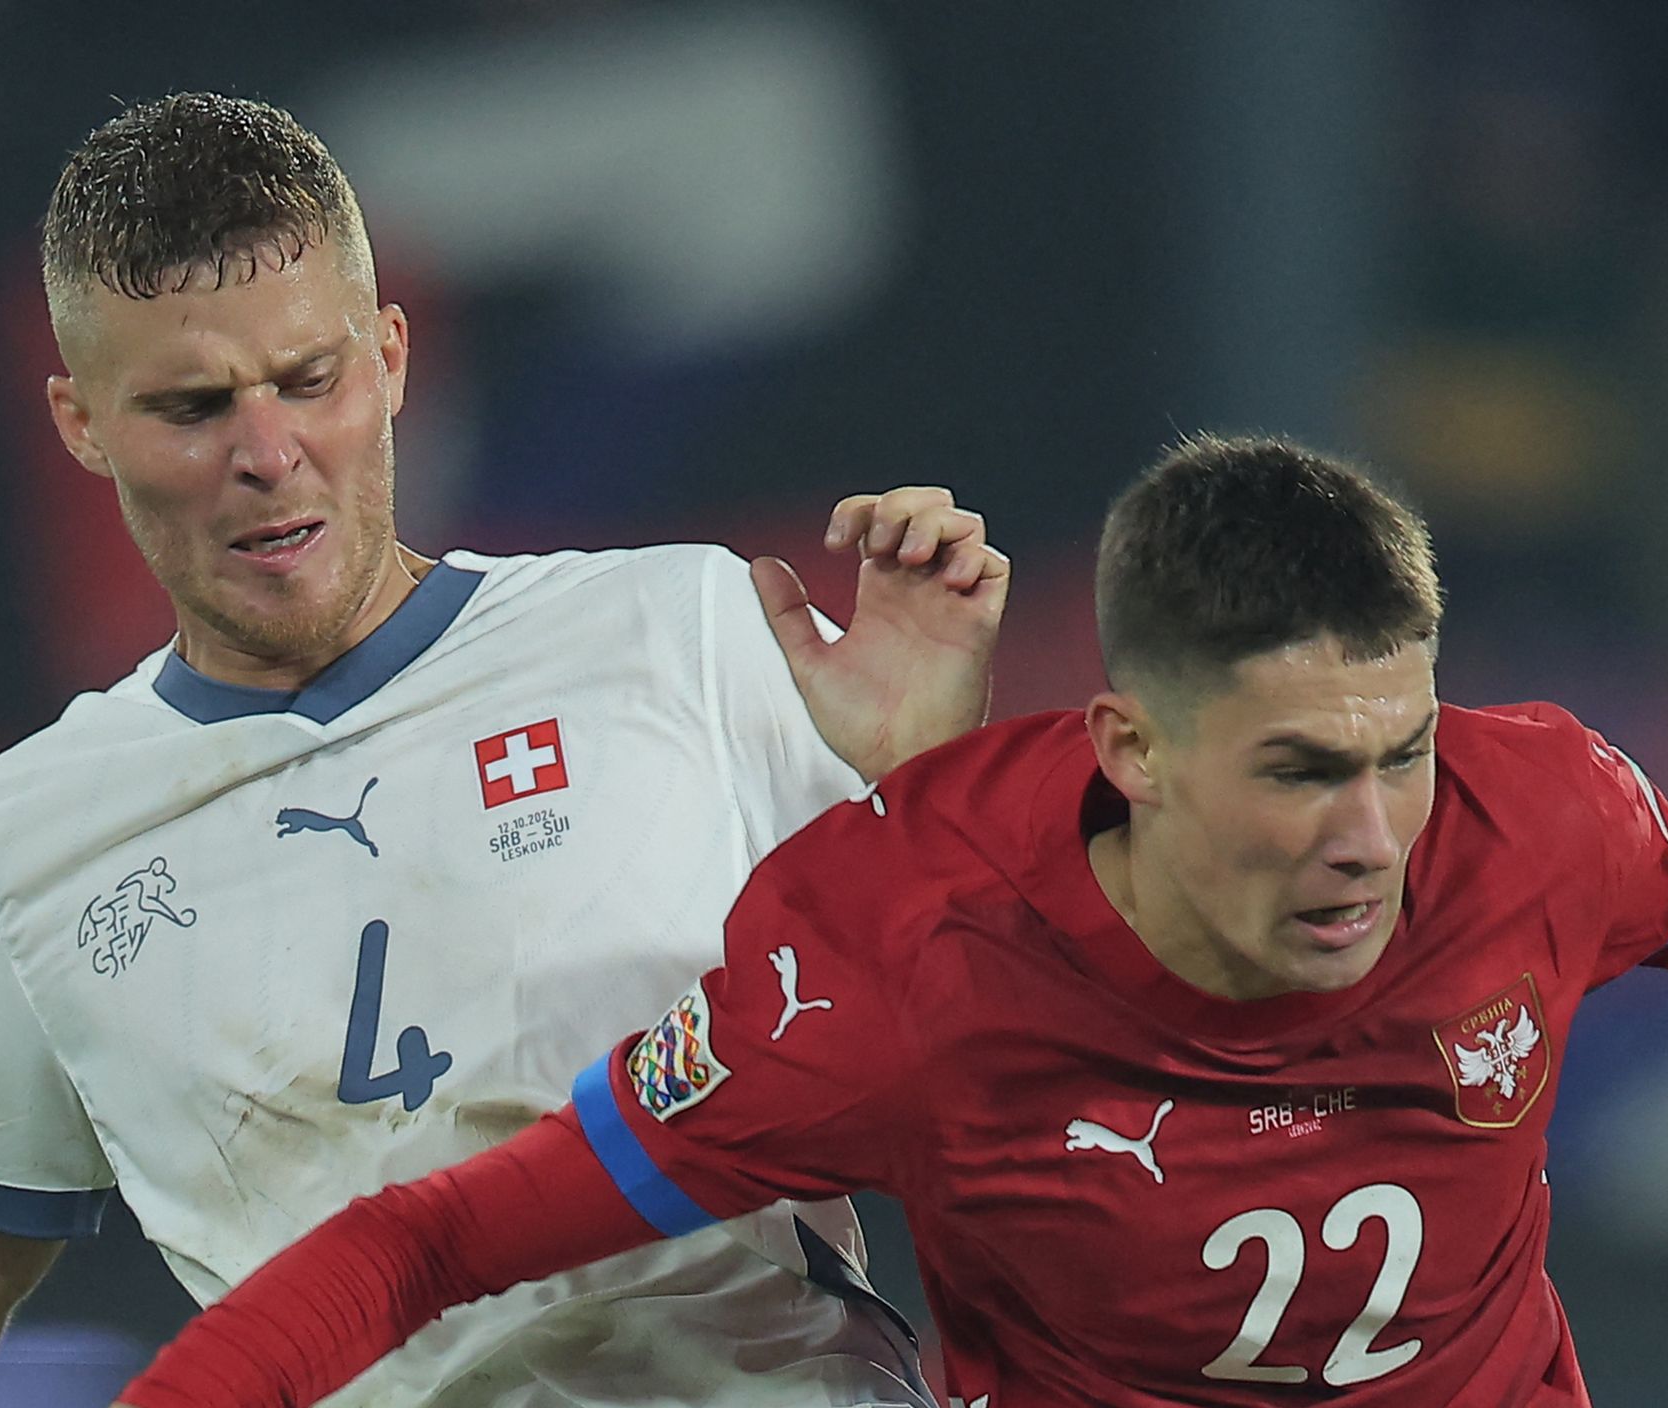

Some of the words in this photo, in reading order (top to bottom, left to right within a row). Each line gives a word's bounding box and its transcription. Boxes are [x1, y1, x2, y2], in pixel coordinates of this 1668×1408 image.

[490, 831, 521, 853] SRB
[543, 816, 570, 835] SUI
[498, 809, 555, 833] 12.10.2024
[501, 835, 562, 862] LESKOVAC
[337, 918, 453, 1113] 4
[1248, 1102, 1295, 1135] SRB
[1313, 1086, 1358, 1119] CHE
[1200, 1182, 1425, 1388] 22
